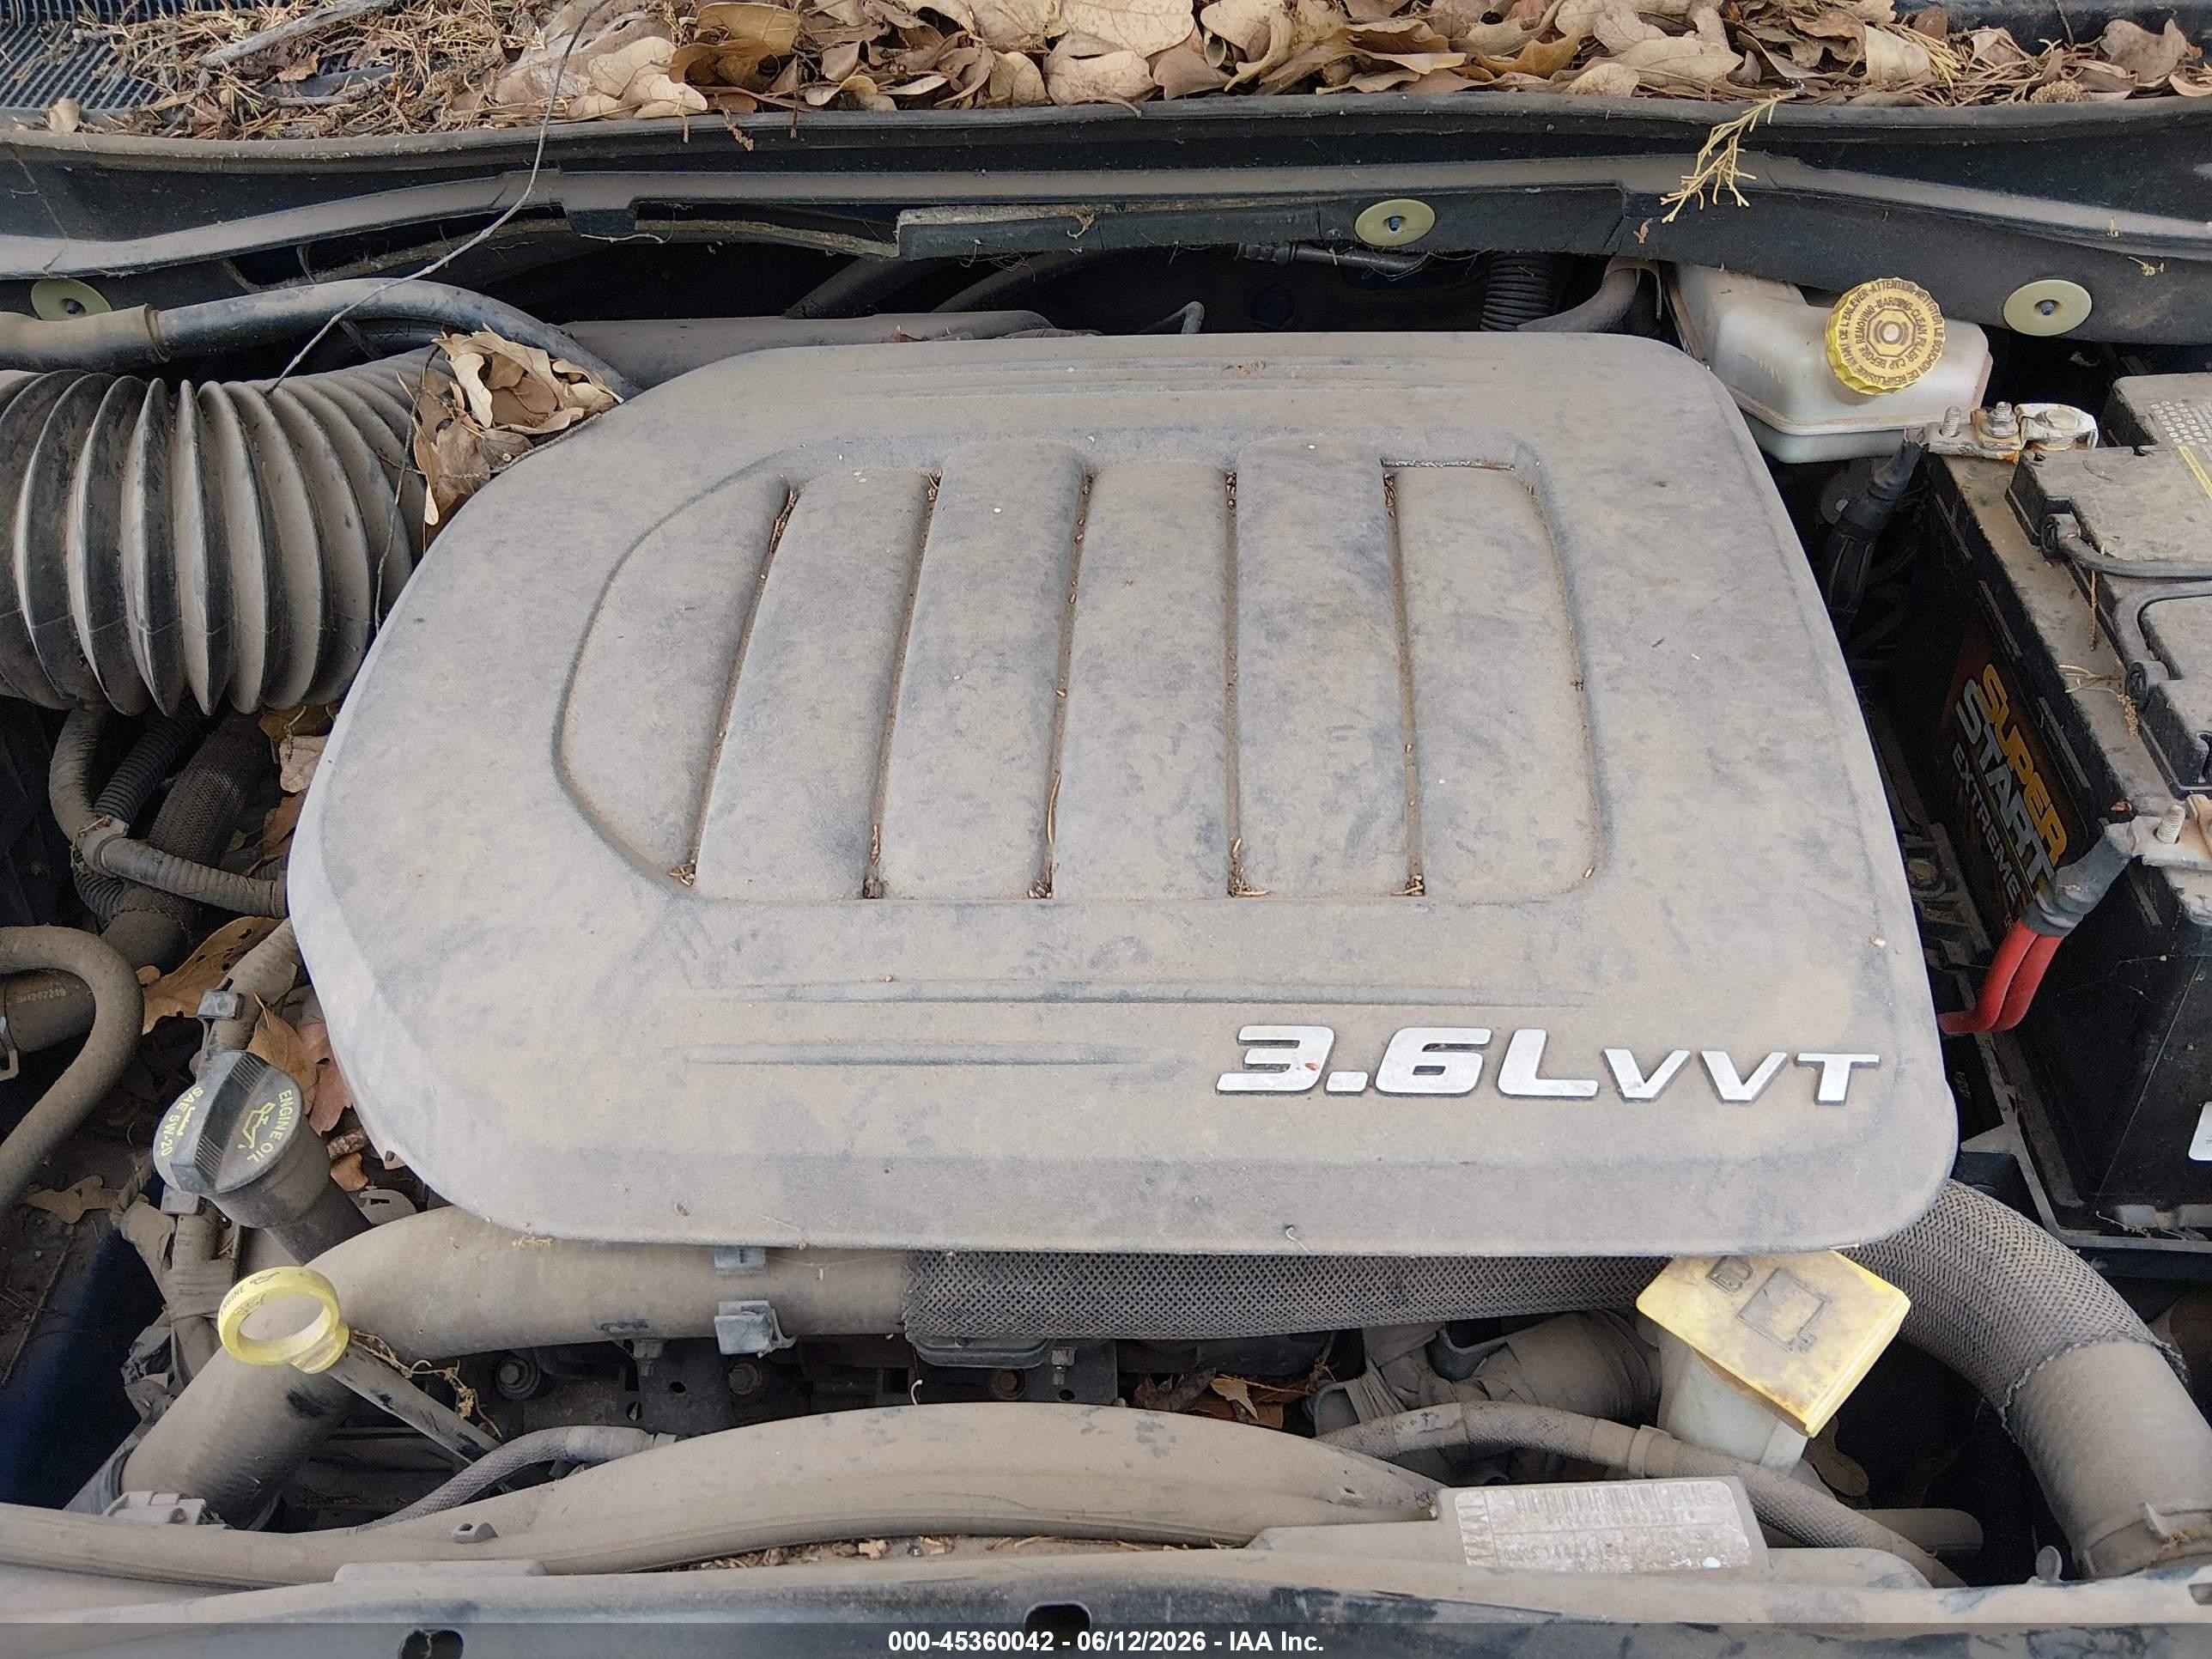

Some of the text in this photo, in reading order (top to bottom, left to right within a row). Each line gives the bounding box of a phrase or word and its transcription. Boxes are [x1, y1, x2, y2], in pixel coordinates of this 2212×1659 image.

[1839, 329, 1848, 340] DE
[1907, 337, 1927, 362] FILLER
[1858, 344, 1887, 369] BEFORE
[1889, 358, 1905, 369] CAP
[1921, 339, 1942, 374] BOUCHON
[1907, 369, 1920, 381] DE
[1955, 678, 2055, 884] START
[1978, 664, 2068, 866] SUPER
[1953, 742, 2021, 904] EXTREME
[161, 1086, 204, 1157] SAE 5W-20
[247, 1089, 294, 1163] ENGINE OIL
